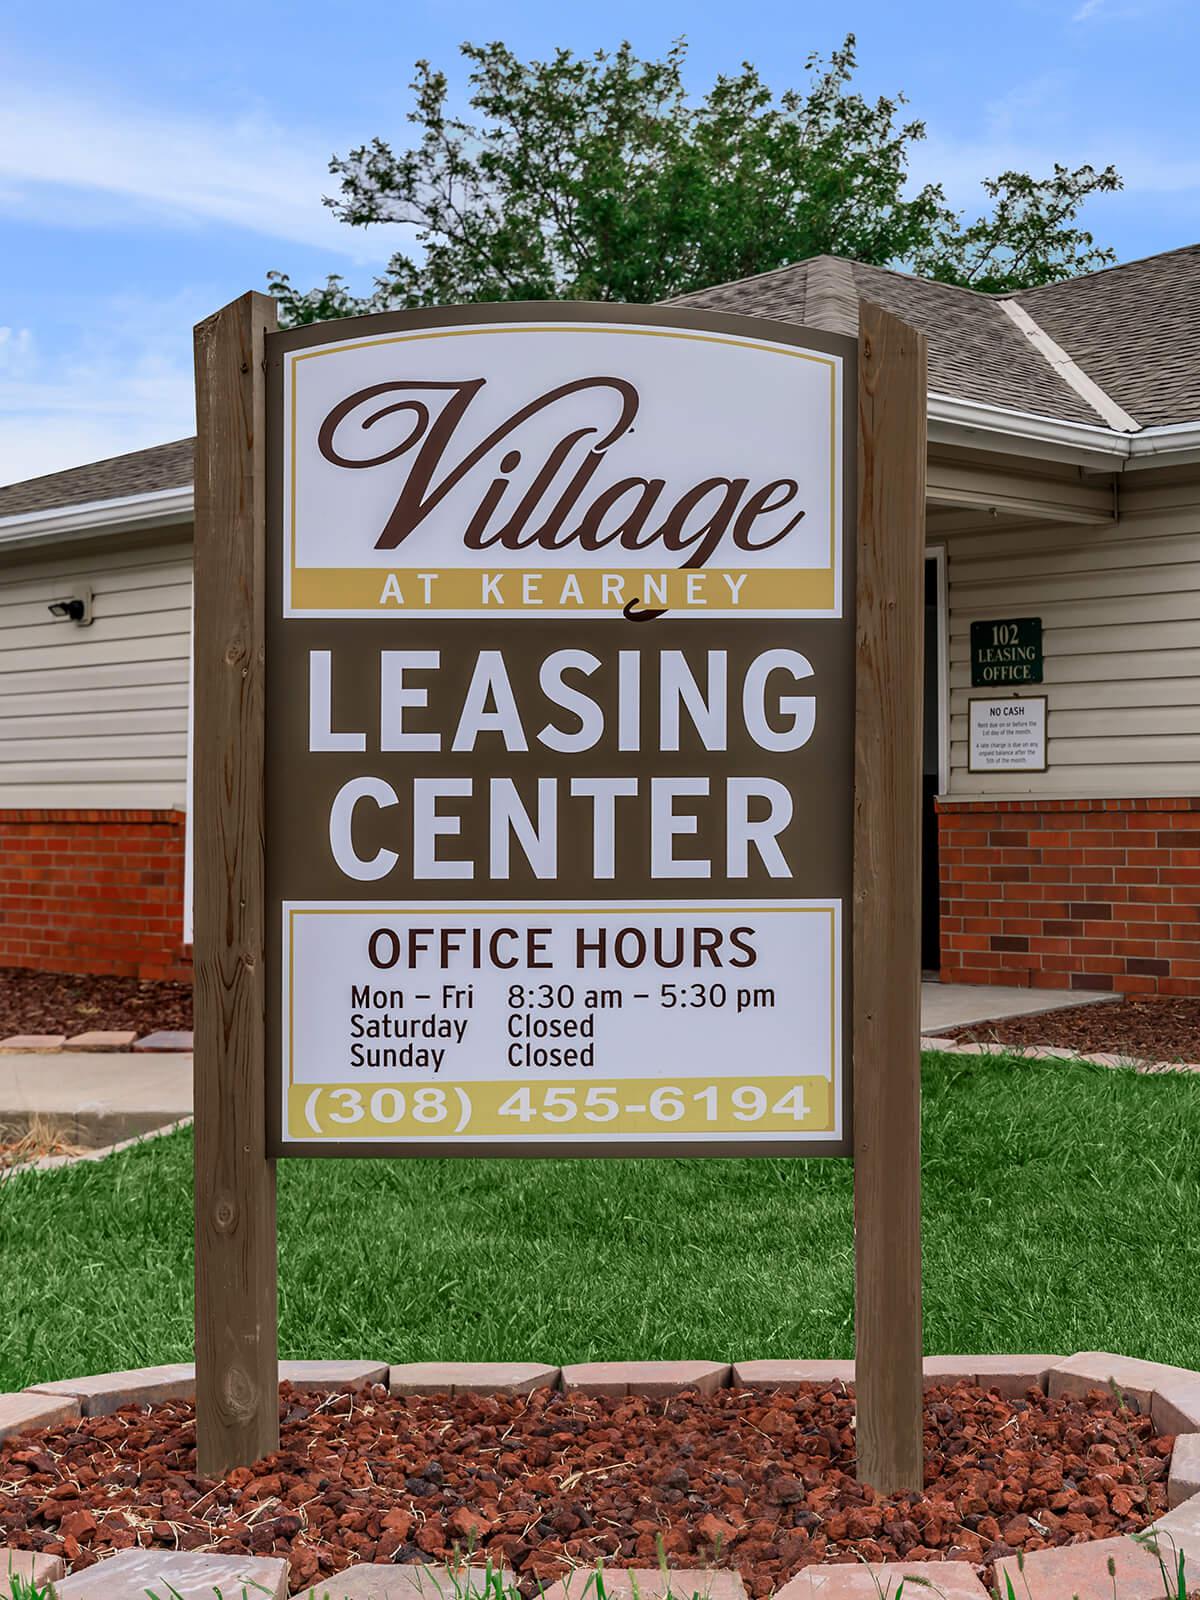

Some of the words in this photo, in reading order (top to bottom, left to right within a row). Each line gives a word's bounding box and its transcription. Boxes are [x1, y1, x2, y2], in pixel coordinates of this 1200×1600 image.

[317, 376, 806, 622] Village
[379, 573, 439, 604] AT
[481, 572, 749, 604] KEARNEY
[992, 624, 1019, 645] 102
[978, 646, 1036, 663] LEASING
[984, 665, 1031, 680] OFFICE
[309, 648, 817, 753] LEASING
[990, 707, 1001, 716] NO
[1004, 706, 1024, 716] CASH
[329, 776, 794, 880] CENTER
[368, 927, 553, 969] OFFICE
[576, 926, 758, 969] HOURS
[351, 985, 404, 1009] Mon
[442, 984, 474, 1009] Fri
[508, 984, 575, 1009] 8:30
[584, 988, 622, 1009] am
[660, 983, 727, 1008] 5:30
[736, 987, 776, 1013] pm
[350, 1013, 468, 1044] Saturday
[507, 1013, 595, 1038] Closed
[350, 1042, 446, 1073] Sunday
[507, 1042, 595, 1067] Closed
[304, 1087, 473, 1133] (308)
[497, 1084, 811, 1123] 455-6194
